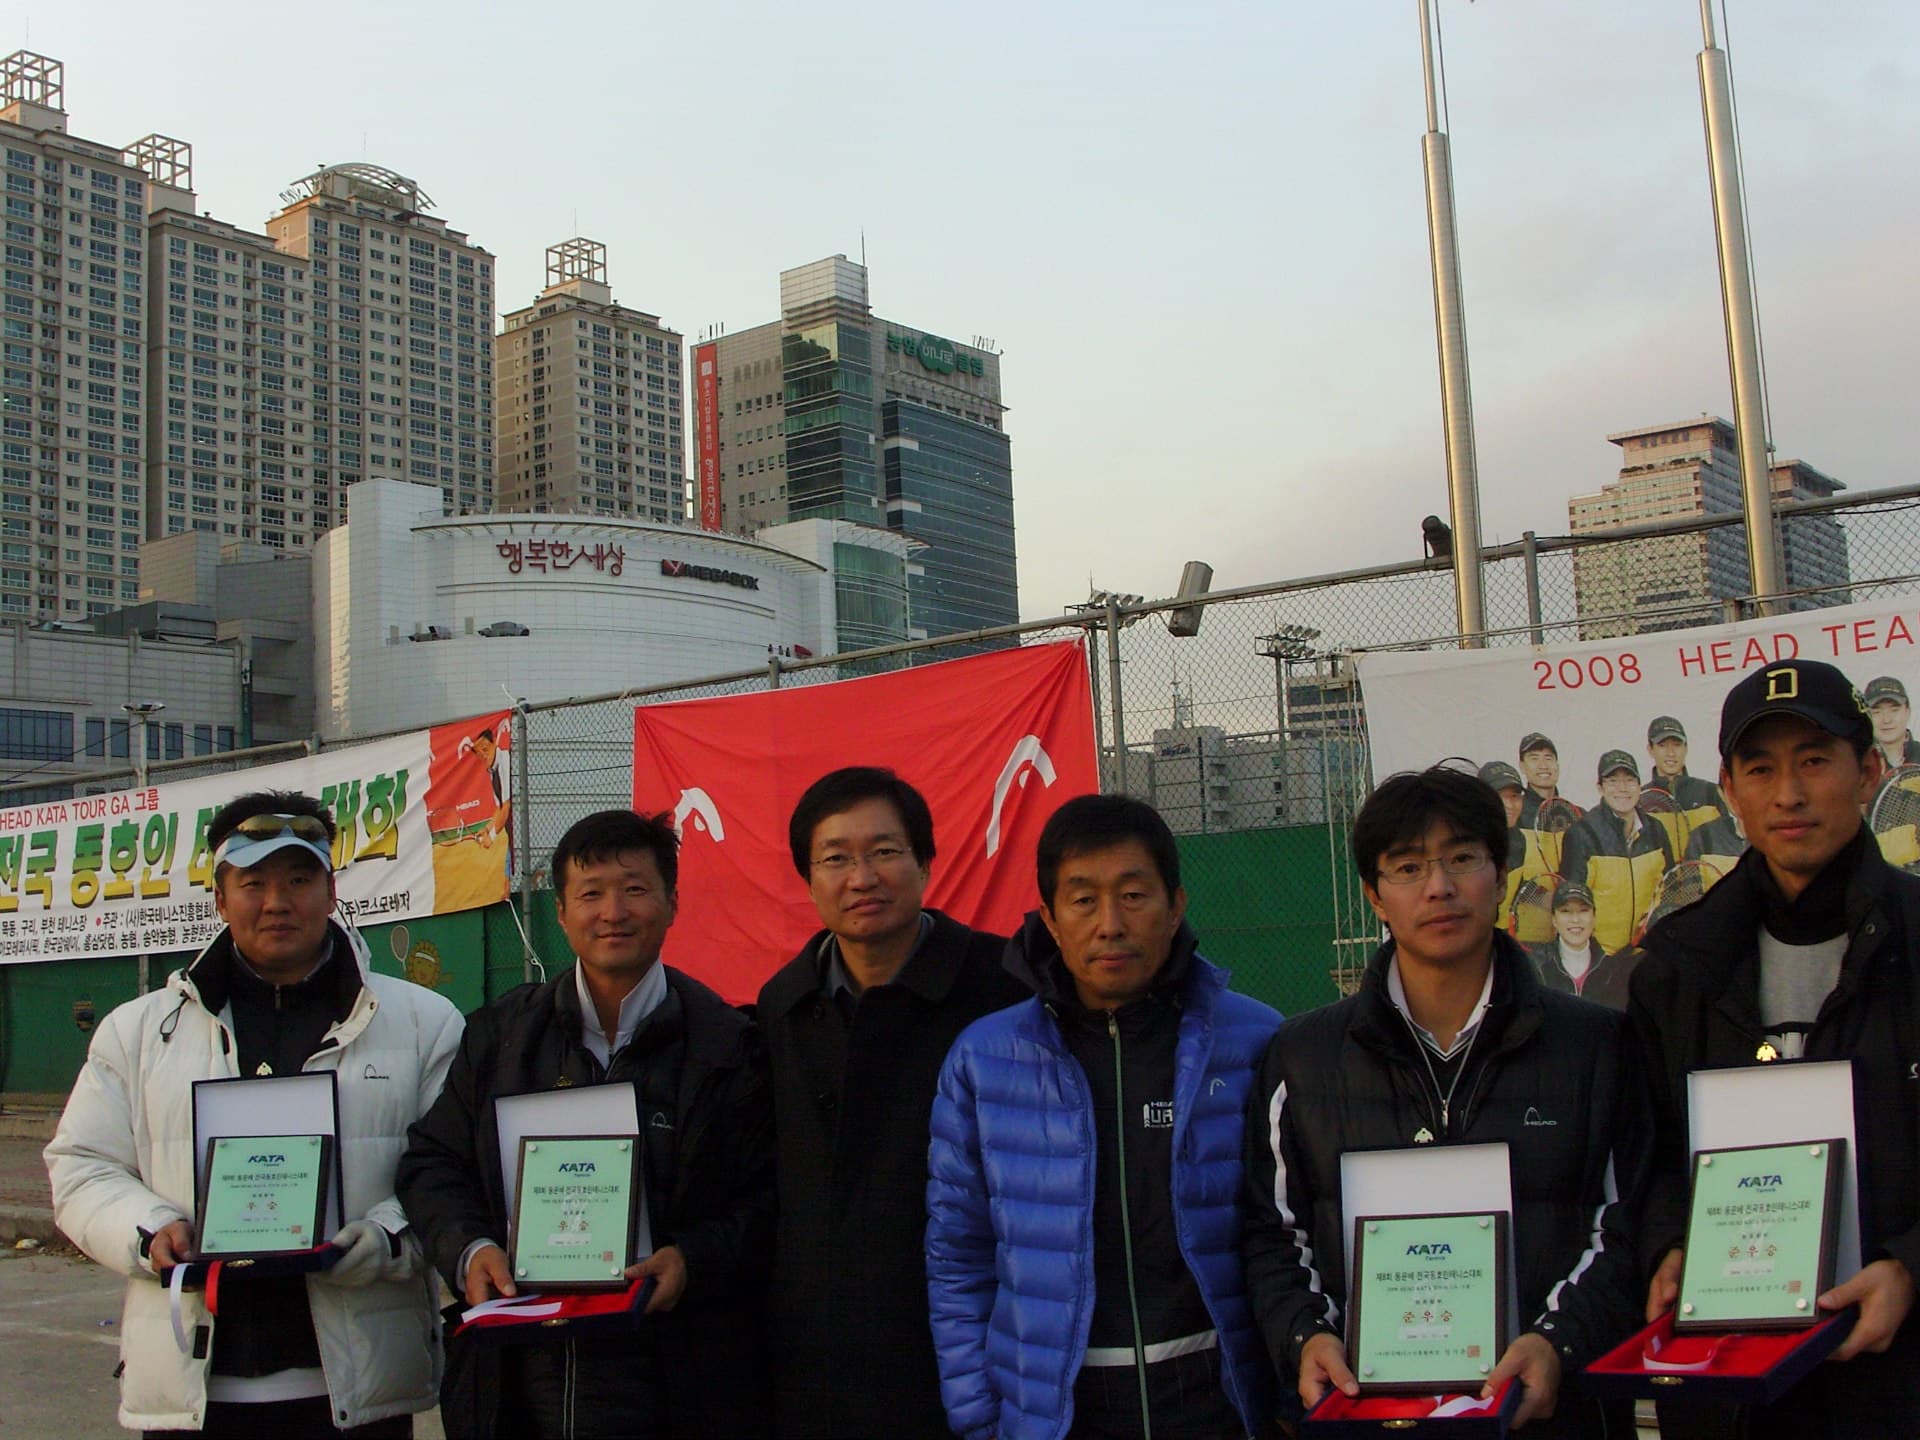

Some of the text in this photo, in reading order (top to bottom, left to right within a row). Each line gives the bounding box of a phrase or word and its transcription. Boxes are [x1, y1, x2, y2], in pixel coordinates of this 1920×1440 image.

[496, 538, 626, 577] 행복한세상
[685, 562, 760, 591] MEGABOX
[1533, 610, 1920, 691] 2008 HEAD TEA
[1766, 667, 1799, 701] D
[0, 788, 160, 831] HEAD KATA TOUR GA 그룹
[0, 829, 58, 914] 전국
[71, 811, 179, 909] 동호인
[57, 913, 88, 933] 테니스장
[103, 911, 118, 930] 주관
[248, 1154, 286, 1164] KATA
[558, 1162, 597, 1173] KATA
[1737, 1174, 1784, 1189] KATA
[1405, 1243, 1453, 1256] KATA
